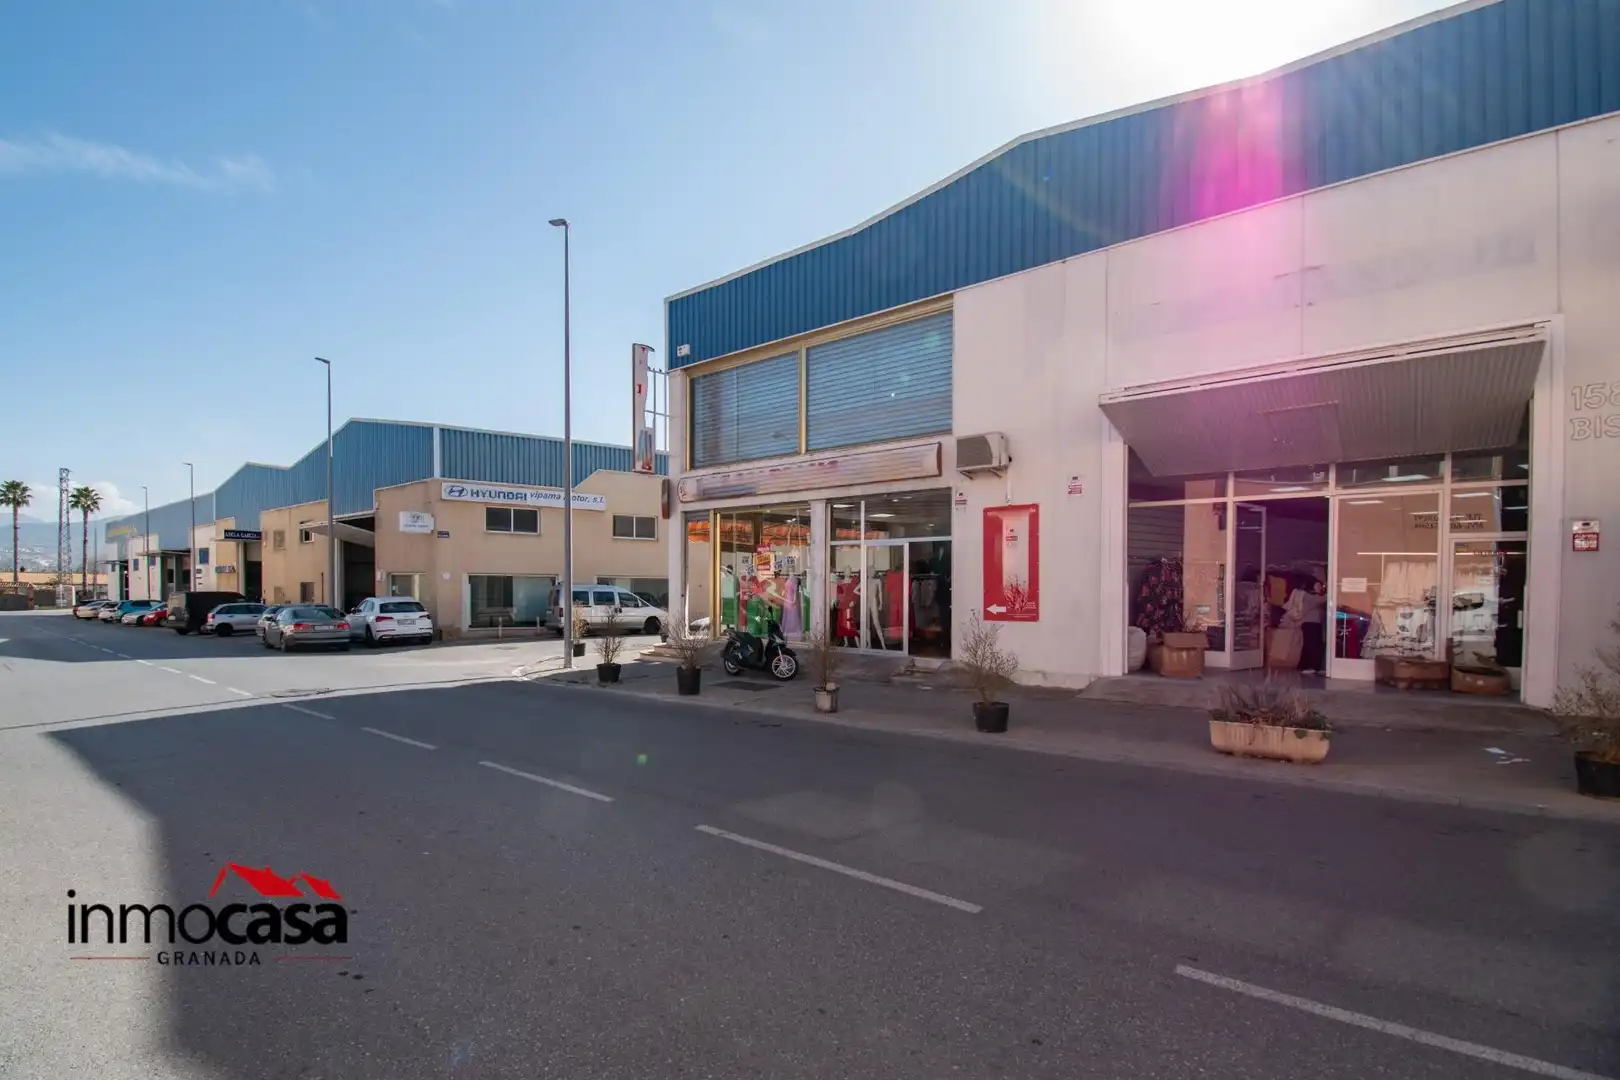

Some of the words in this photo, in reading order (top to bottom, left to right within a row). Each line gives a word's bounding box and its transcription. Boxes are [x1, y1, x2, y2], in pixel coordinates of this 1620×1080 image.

[1569, 413, 1620, 440] BIS
[470, 489, 527, 500] HYUNDAI
[530, 491, 561, 501] vipama
